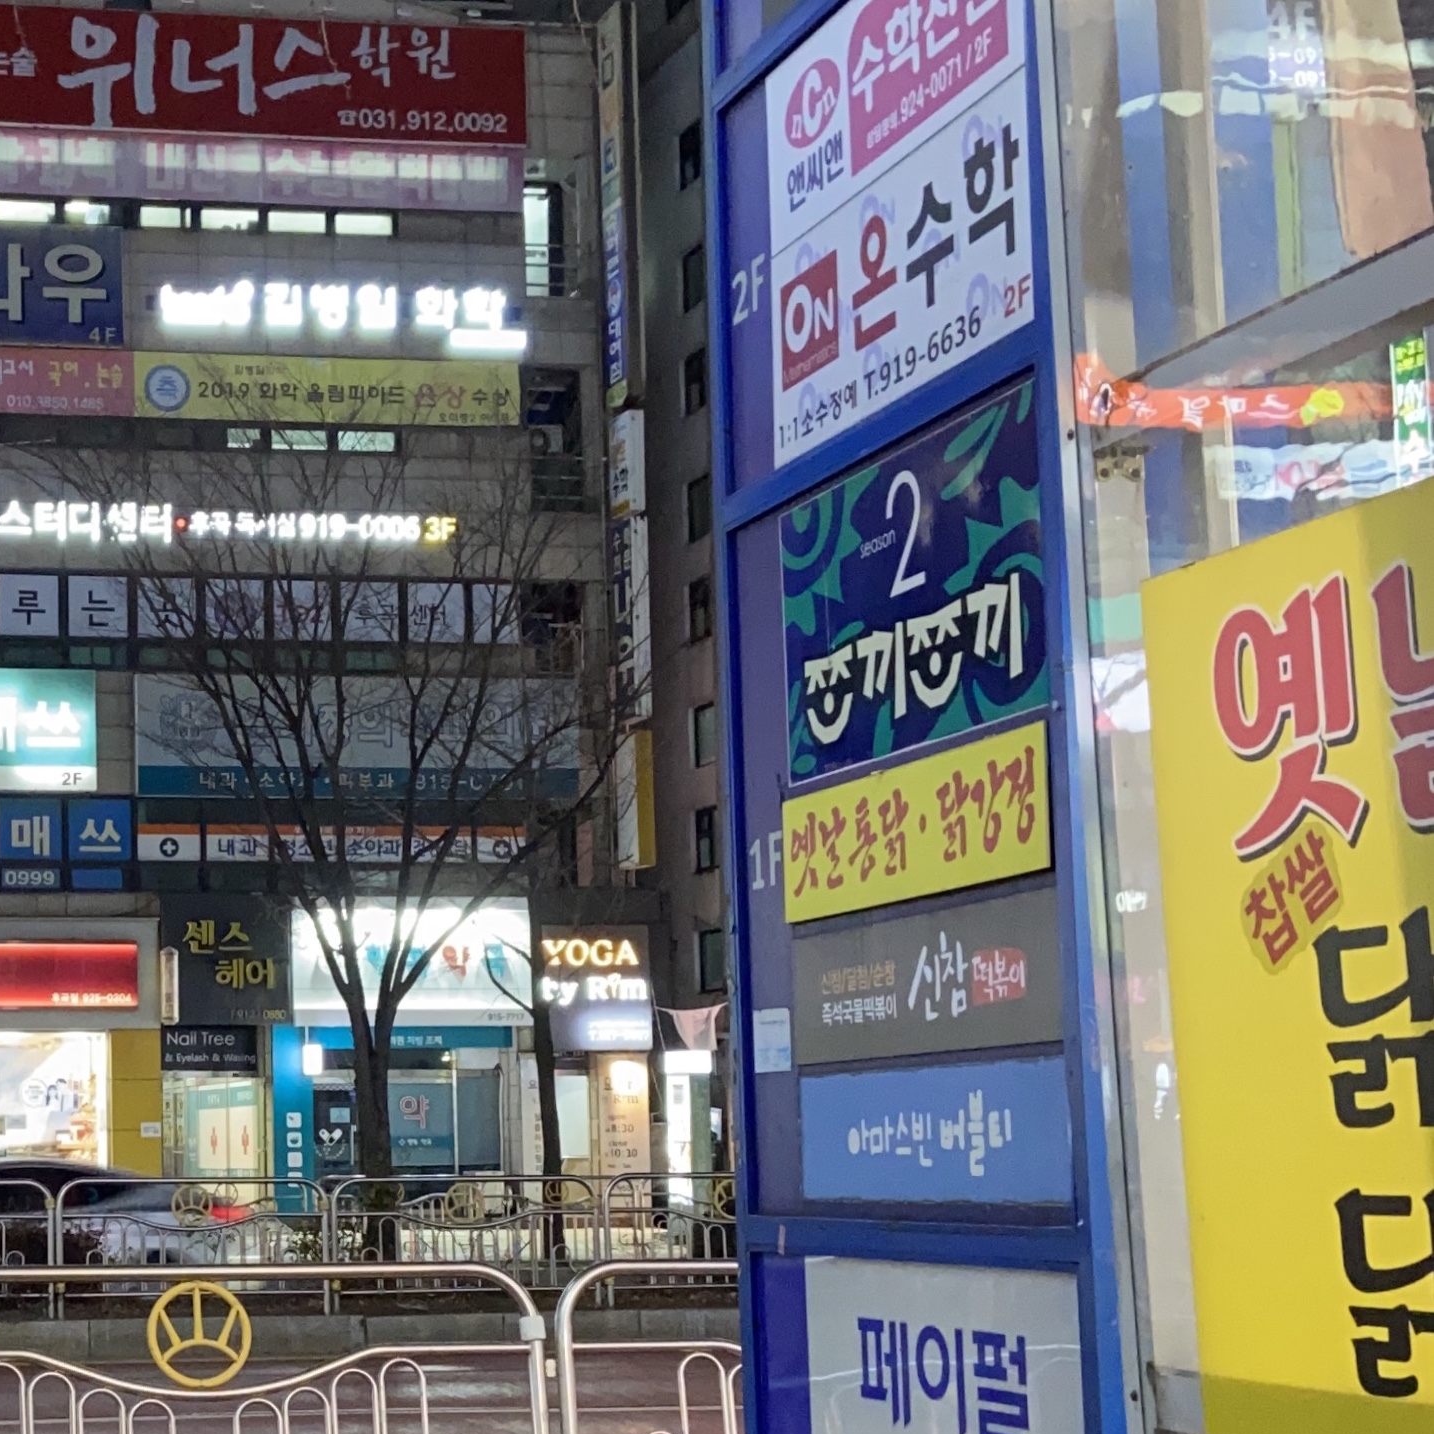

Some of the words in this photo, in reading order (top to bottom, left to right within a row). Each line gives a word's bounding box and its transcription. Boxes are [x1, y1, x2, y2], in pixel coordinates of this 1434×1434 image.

[58, 13, 352, 129] 위너스
[352, 26, 457, 88] 학원
[358, 109, 508, 133] 031.912.0092
[786, 130, 845, 213] 앤씨앤
[852, 123, 1020, 352] 온수학
[732, 253, 766, 327] 2F
[1004, 273, 1032, 319] 2F
[89, 327, 117, 342] 4F
[784, 283, 835, 354] ON
[863, 305, 982, 400] T.919-6636
[198, 381, 250, 399] 2019
[259, 382, 299, 401] 화학
[424, 515, 457, 542] 3F
[859, 527, 897, 561] season
[885, 469, 927, 599] 2
[61, 772, 84, 786] 2F
[935, 745, 1036, 864] 닭강정
[217, 838, 258, 858] 내과
[1244, 829, 1340, 966] 찹쌀
[182, 919, 253, 955] 센스
[541, 938, 640, 966] YOGA
[215, 957, 277, 990] 헤어
[971, 949, 1026, 1001] 떡볶이
[166, 1032, 198, 1046] Nail
[202, 1032, 236, 1046] Tree
[176, 1053, 210, 1065] Eyelash
[399, 1095, 430, 1130] 약
[847, 1111, 933, 1168] 아마스빈
[939, 1088, 1012, 1177] 버블티
